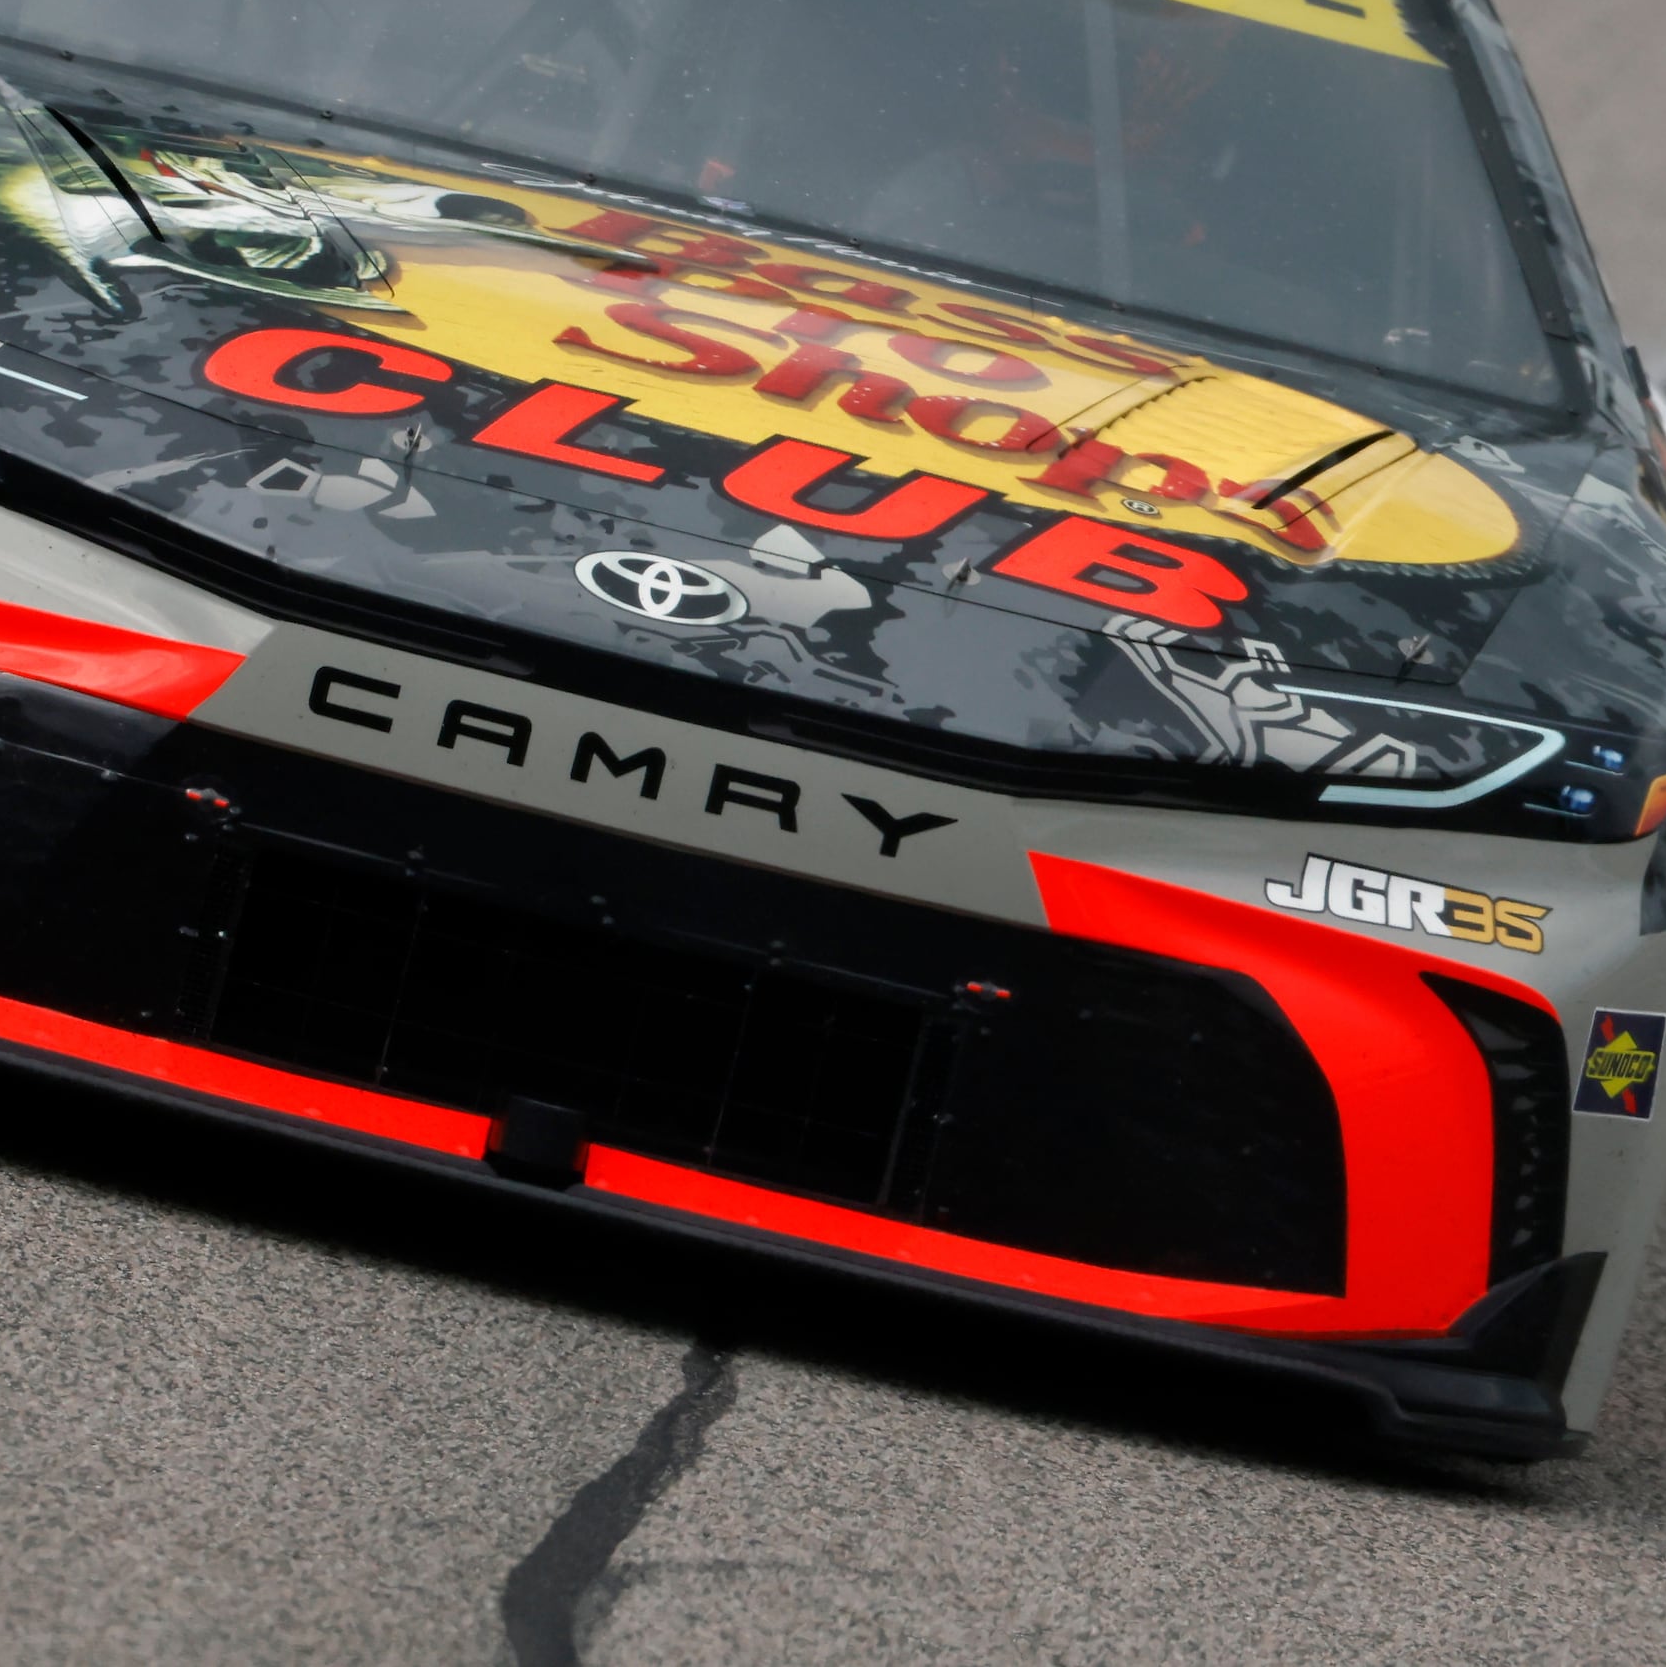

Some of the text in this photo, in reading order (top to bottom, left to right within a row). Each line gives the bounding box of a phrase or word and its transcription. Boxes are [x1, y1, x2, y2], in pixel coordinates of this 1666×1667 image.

[547, 207, 1183, 378] Bass
[201, 327, 1250, 629] CLUB
[552, 301, 1339, 552] Shops
[307, 664, 960, 859] CAMRY
[1587, 1049, 1655, 1080] SUNOCO
